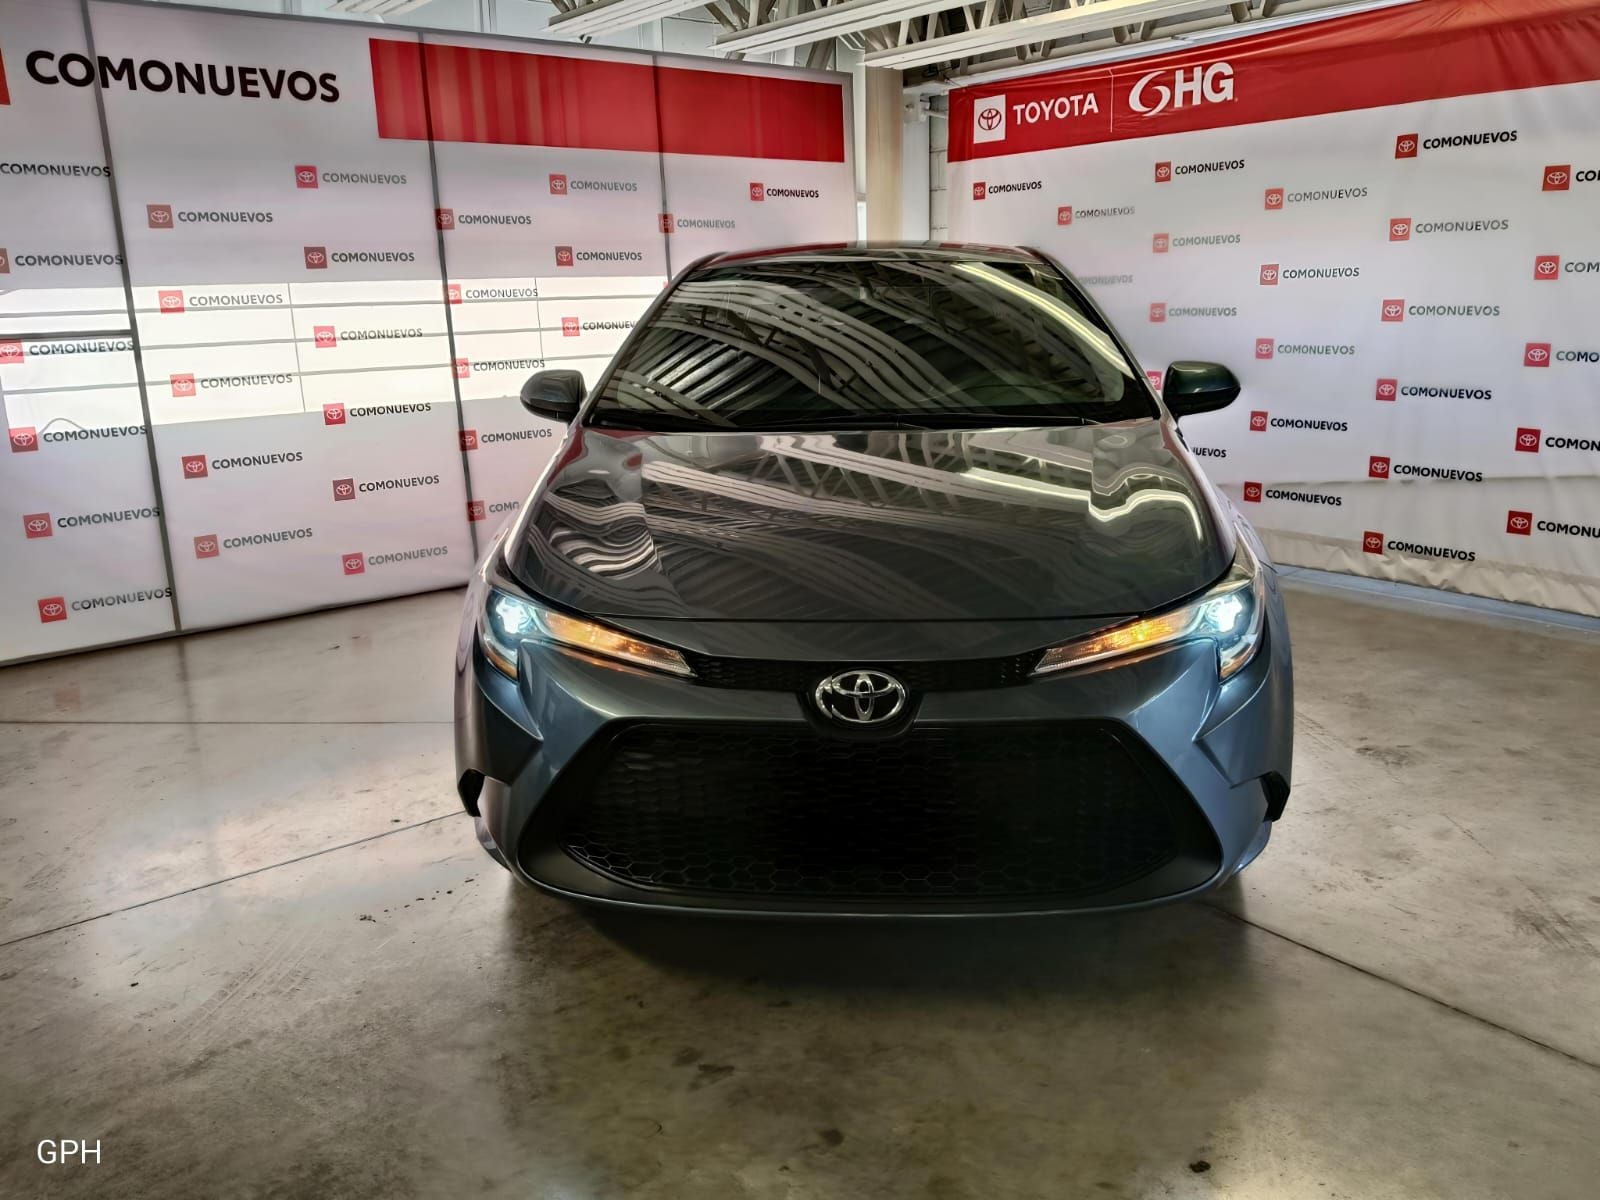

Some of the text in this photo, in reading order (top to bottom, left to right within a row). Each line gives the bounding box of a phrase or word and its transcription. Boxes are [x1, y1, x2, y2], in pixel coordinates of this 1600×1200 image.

[26, 50, 340, 103] COMONUEVOS
[1013, 92, 1099, 125] TOYOTA
[1423, 130, 1517, 150] COMONUEVOS
[0, 162, 111, 178] COMONUEVOS
[1175, 159, 1244, 175] COMONUEVOS
[322, 172, 407, 185] COMONUEVOS
[1575, 170, 1600, 182] CO
[570, 180, 638, 192] COMONUEVOS
[766, 187, 819, 198] COMONUEVOS
[989, 181, 1042, 194] COMONUEVOS
[1287, 188, 1368, 203] COMONUEVOS
[178, 212, 273, 224] COMONUEVOS
[458, 213, 531, 225] COMONUEVOS
[1075, 206, 1135, 218] COMONUEVOS
[677, 218, 735, 230] COMONUEVOS
[1415, 219, 1508, 234] COMONUEVOS
[1172, 234, 1240, 247] COMONUEVOS
[15, 254, 123, 267] COMONUEVOS
[331, 251, 415, 264] COMONUEVOS
[576, 250, 643, 262] COMONUEVOS
[1283, 267, 1359, 280] COMONUEVOS
[189, 293, 283, 307] COMONUEVOS
[466, 286, 538, 300] COMONUEVOS
[1169, 307, 1236, 317] COMONUEVOS
[1409, 305, 1500, 317] COMONUEVOS
[340, 327, 423, 341] COMONUEVOS
[29, 340, 135, 356] COMONUEVOS
[1278, 344, 1355, 355] COMONUEVOS
[1556, 350, 1600, 363] COMO
[474, 359, 545, 371] COMONUEVOS
[200, 373, 293, 390] COMONUEVOS
[1401, 385, 1492, 400] COMONUEVOS
[350, 402, 431, 418] COMONUEVOS
[1270, 417, 1348, 431] COMONUEVOS
[43, 425, 147, 443] COMONUEVOS
[481, 428, 552, 443] COMONUEVOS
[212, 451, 303, 471] COMONUEVOS
[1393, 464, 1482, 482] COMONUEVOS
[359, 475, 439, 493] COMONUEVOS
[1266, 489, 1342, 506] COMONUEVOS
[57, 507, 160, 529] COMONUEVOS
[223, 528, 313, 549] COMONUEVOS
[368, 545, 448, 566] COMONUEVOS
[1388, 540, 1475, 561] COMONUEVOS
[71, 587, 172, 612] COMONUEVOS
